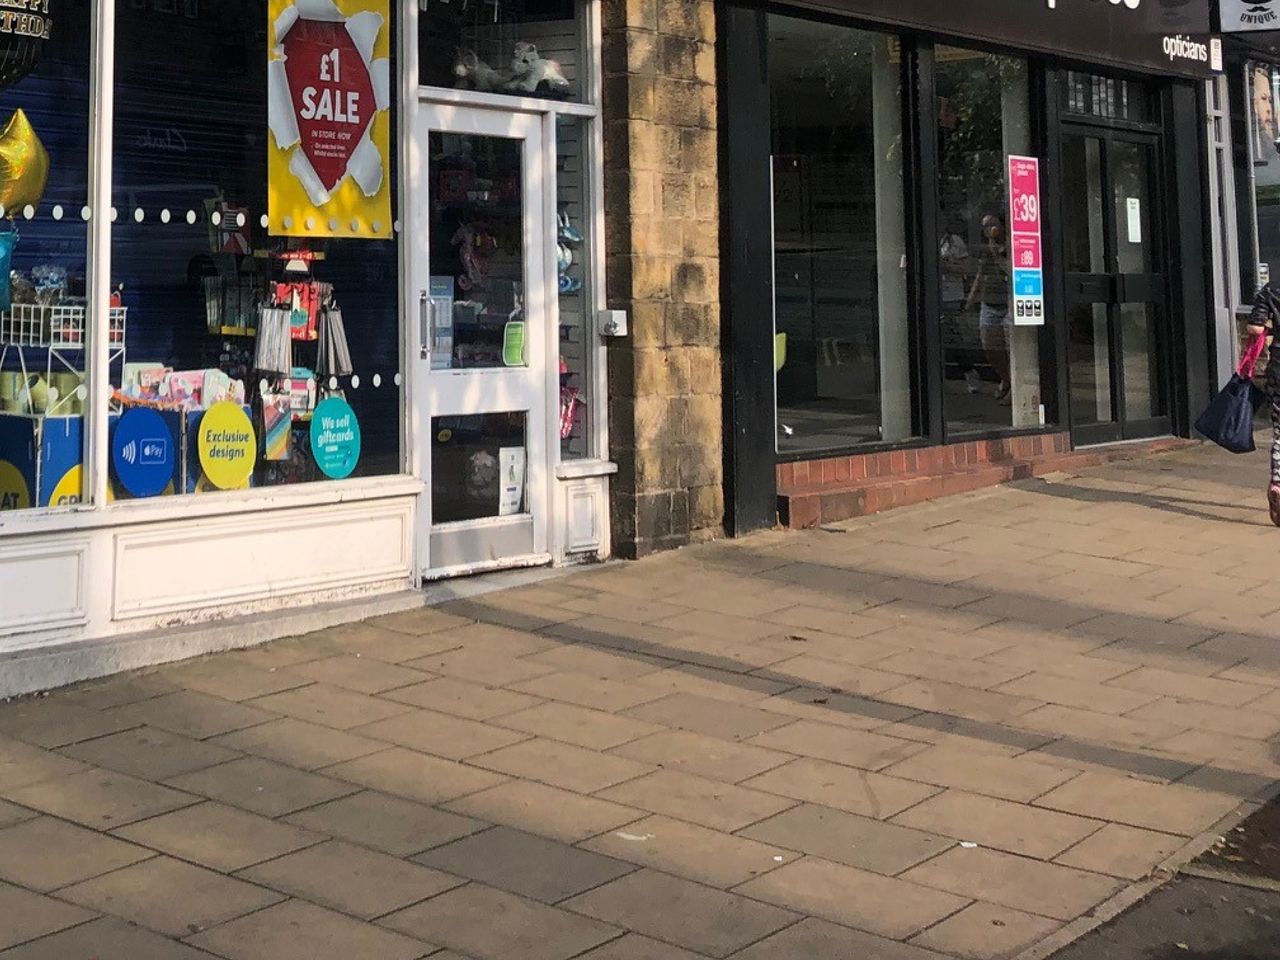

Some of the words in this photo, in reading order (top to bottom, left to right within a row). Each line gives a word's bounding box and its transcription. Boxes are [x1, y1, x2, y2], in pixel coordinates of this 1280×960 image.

[1240, 10, 1277, 24] UNIQUE
[1163, 34, 1208, 62] opticians
[320, 48, 340, 83] £1
[300, 86, 360, 125] SALE
[1013, 193, 1037, 222] £39
[322, 417, 335, 429] We
[335, 415, 350, 428] sell
[206, 429, 249, 443] Exclusive
[318, 429, 355, 447] giftcards
[209, 445, 245, 461] designs
